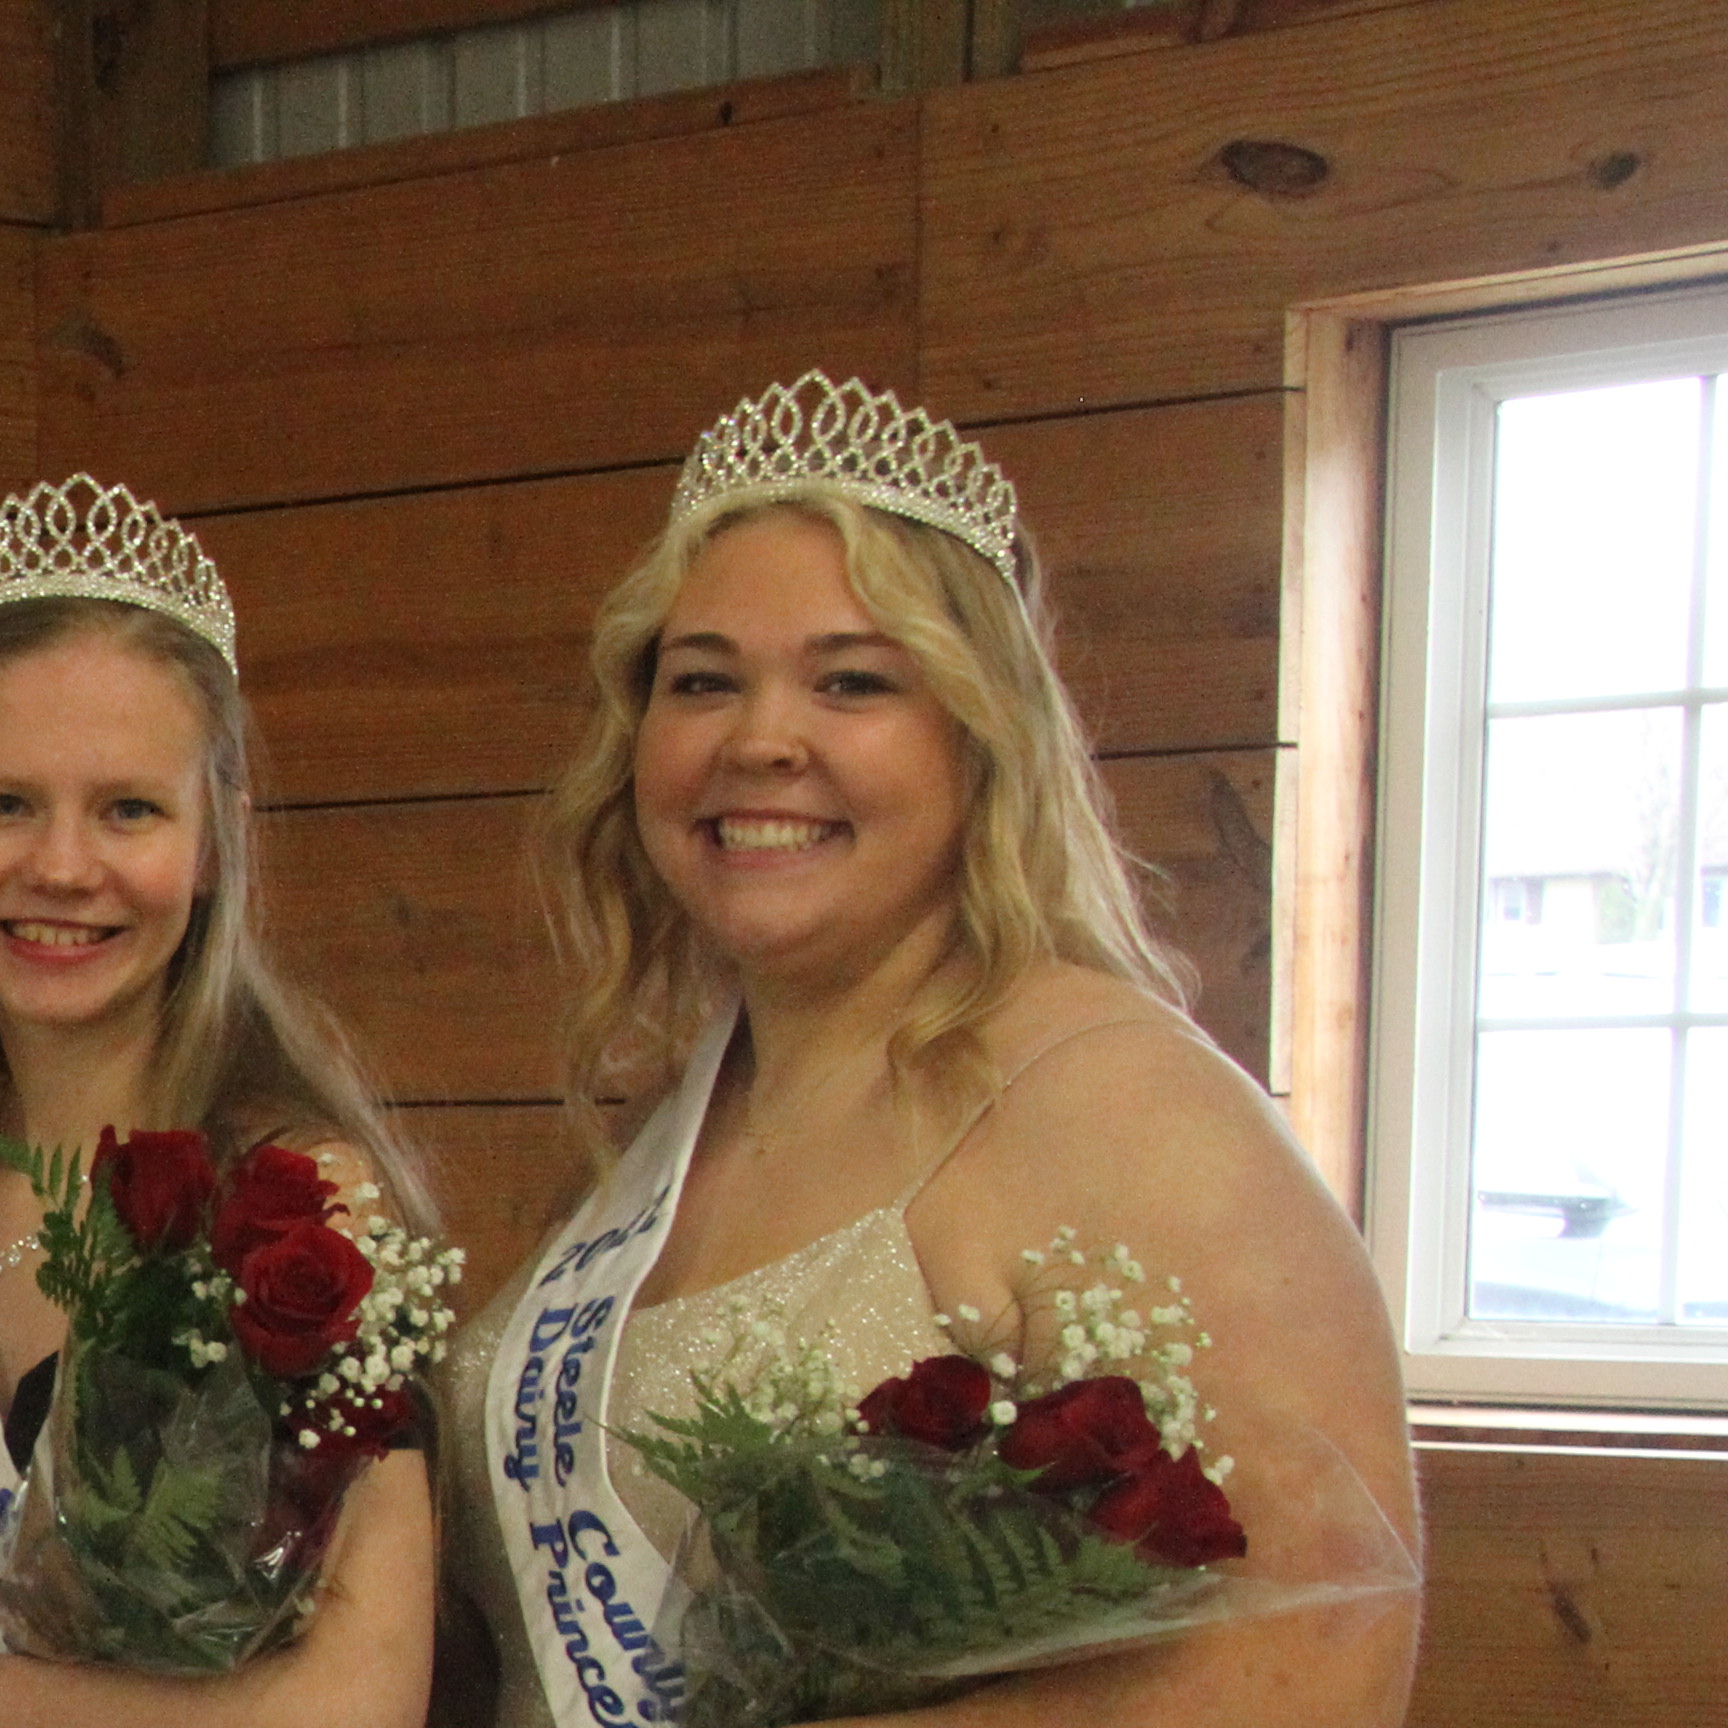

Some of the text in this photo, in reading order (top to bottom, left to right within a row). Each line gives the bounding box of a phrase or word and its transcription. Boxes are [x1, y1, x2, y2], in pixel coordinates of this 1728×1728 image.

[504, 1302, 578, 1493] Dairy
[553, 1296, 686, 1723] Steele County
